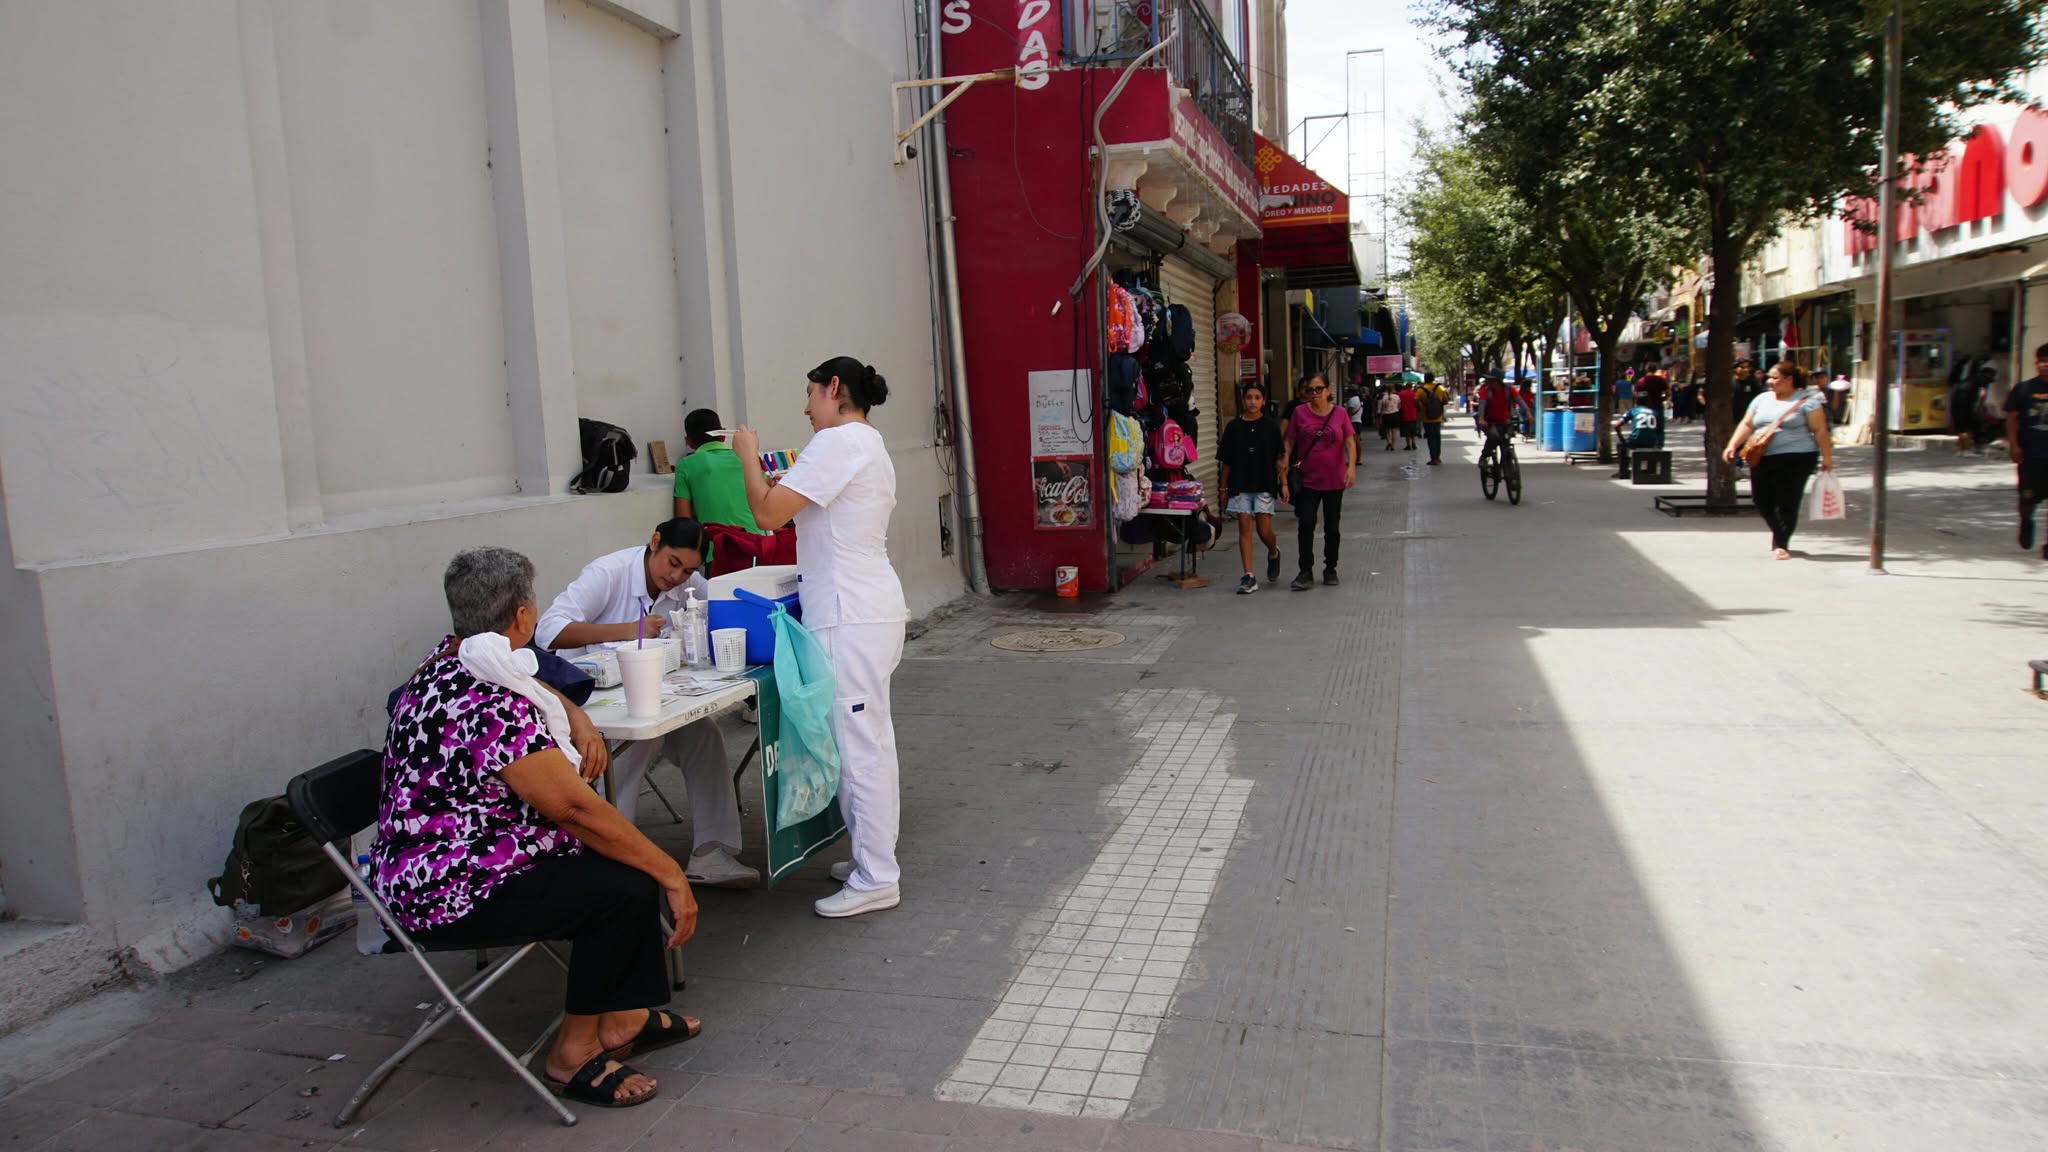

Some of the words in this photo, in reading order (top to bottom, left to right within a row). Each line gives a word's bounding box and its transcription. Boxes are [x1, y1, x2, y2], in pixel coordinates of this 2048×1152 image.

[1017, 0, 1051, 90] DAS
[1260, 182, 1328, 196] VEDADES
[1264, 209, 1286, 217] OREO
[1294, 205, 1333, 214] MENUDEO
[1636, 413, 1657, 428] 20
[684, 707, 702, 721] UMF
